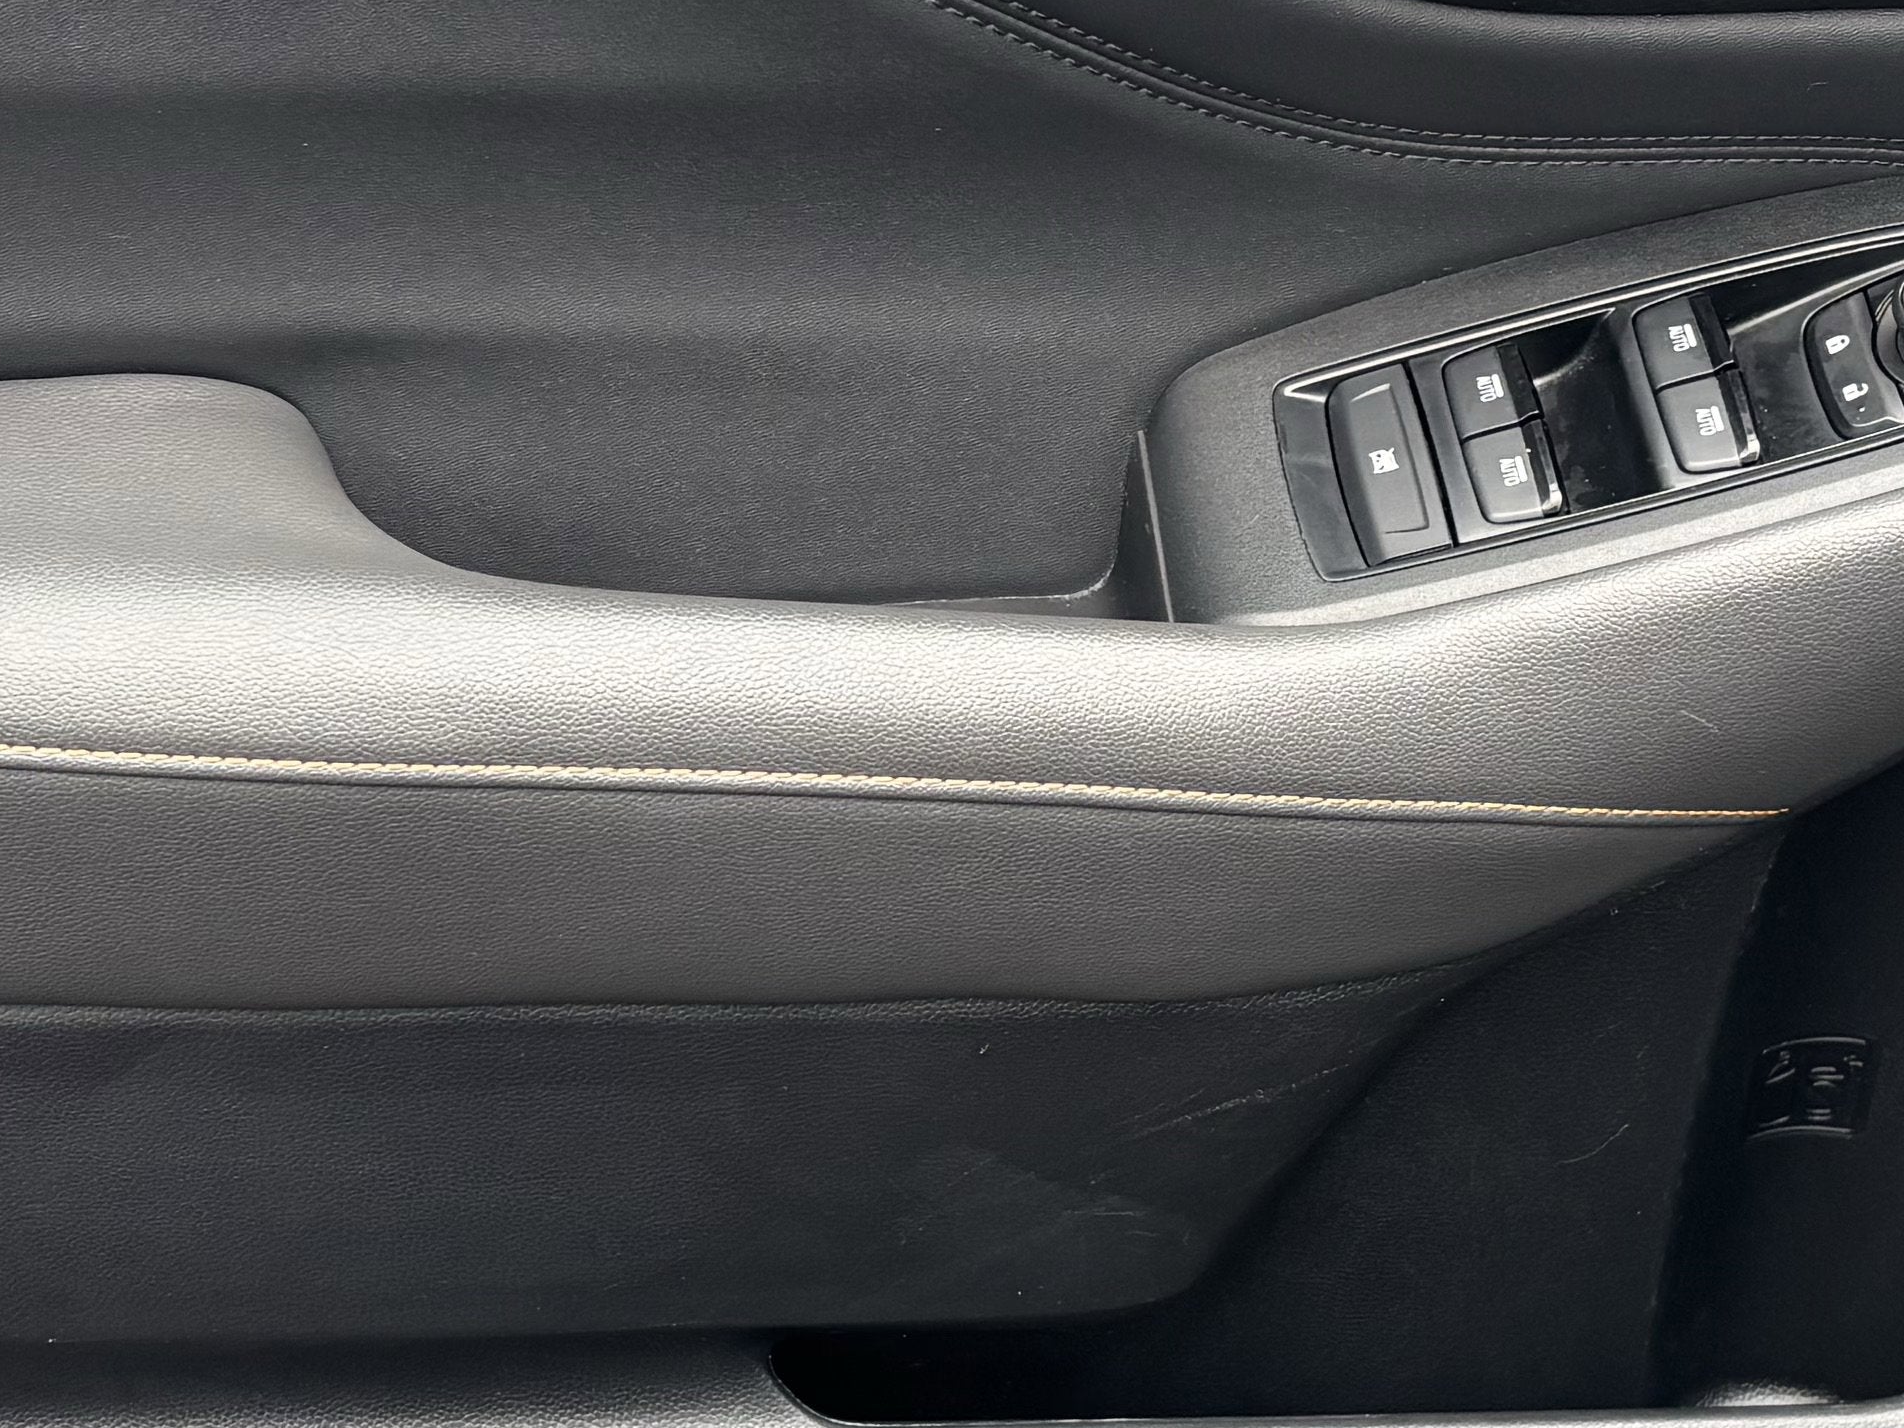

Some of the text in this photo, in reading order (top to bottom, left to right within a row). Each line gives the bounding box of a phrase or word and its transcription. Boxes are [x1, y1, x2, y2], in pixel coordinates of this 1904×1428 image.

[1668, 325, 1690, 352] AUTO
[1476, 376, 1497, 403] AUTO
[1695, 408, 1717, 436] AUTO
[1499, 458, 1520, 487] AUTO
